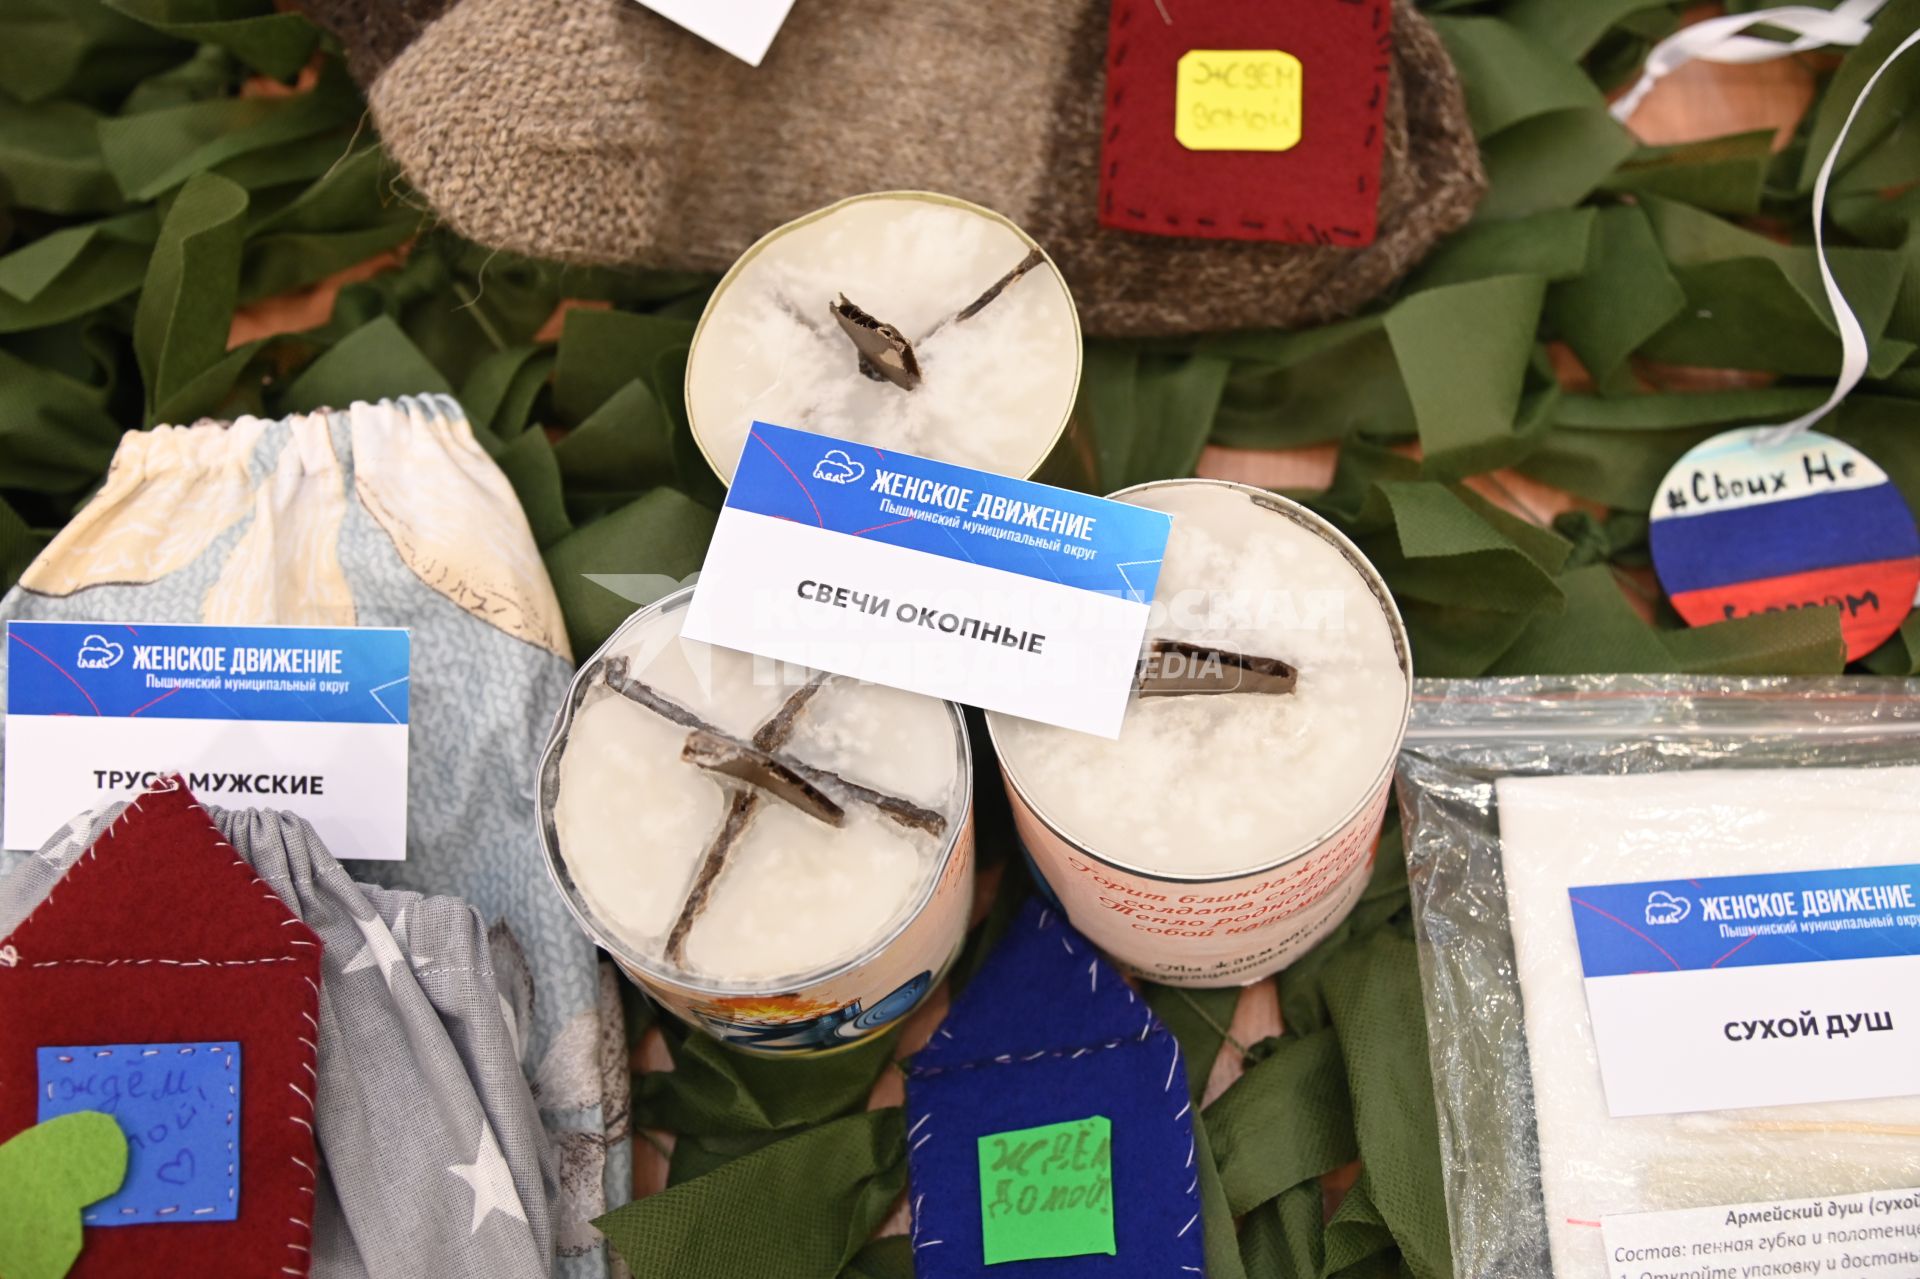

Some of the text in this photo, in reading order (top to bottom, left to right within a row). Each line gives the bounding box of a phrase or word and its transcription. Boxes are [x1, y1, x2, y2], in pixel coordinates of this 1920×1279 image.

[870, 468, 1097, 541] ЖЕНСКОЕ ДВИЖЕНИЕ
[879, 498, 1098, 561] Пышминский муниципальный округ
[797, 578, 1046, 656] СВЕЧИ ОКОПНЫЕ
[132, 644, 343, 675] ЖЕНСКОЕ ДВИЖЕНИЕ
[146, 673, 350, 694] Пышминский муниципальный округ
[93, 770, 324, 795] ТРУС МУЖСКИЕ
[1701, 884, 1916, 922] ЖЕНСКОЕ ДВИЖЕНИЕ
[1131, 922, 1216, 938] собой
[1719, 919, 1799, 939] Пышминский
[1800, 913, 1894, 934] муниципальный
[1723, 1010, 1894, 1042] СУХОЙ ДУШ
[1725, 1201, 1823, 1228] Армейский
[1828, 1200, 1863, 1219] душ
[1614, 1246, 1687, 1263] Состав:
[1692, 1238, 1753, 1256] пенная
[1758, 1231, 1806, 1252] губка
[1812, 1233, 1822, 1245] и
[1742, 1258, 1821, 1279] упаковку
[1826, 1259, 1836, 1271] и
